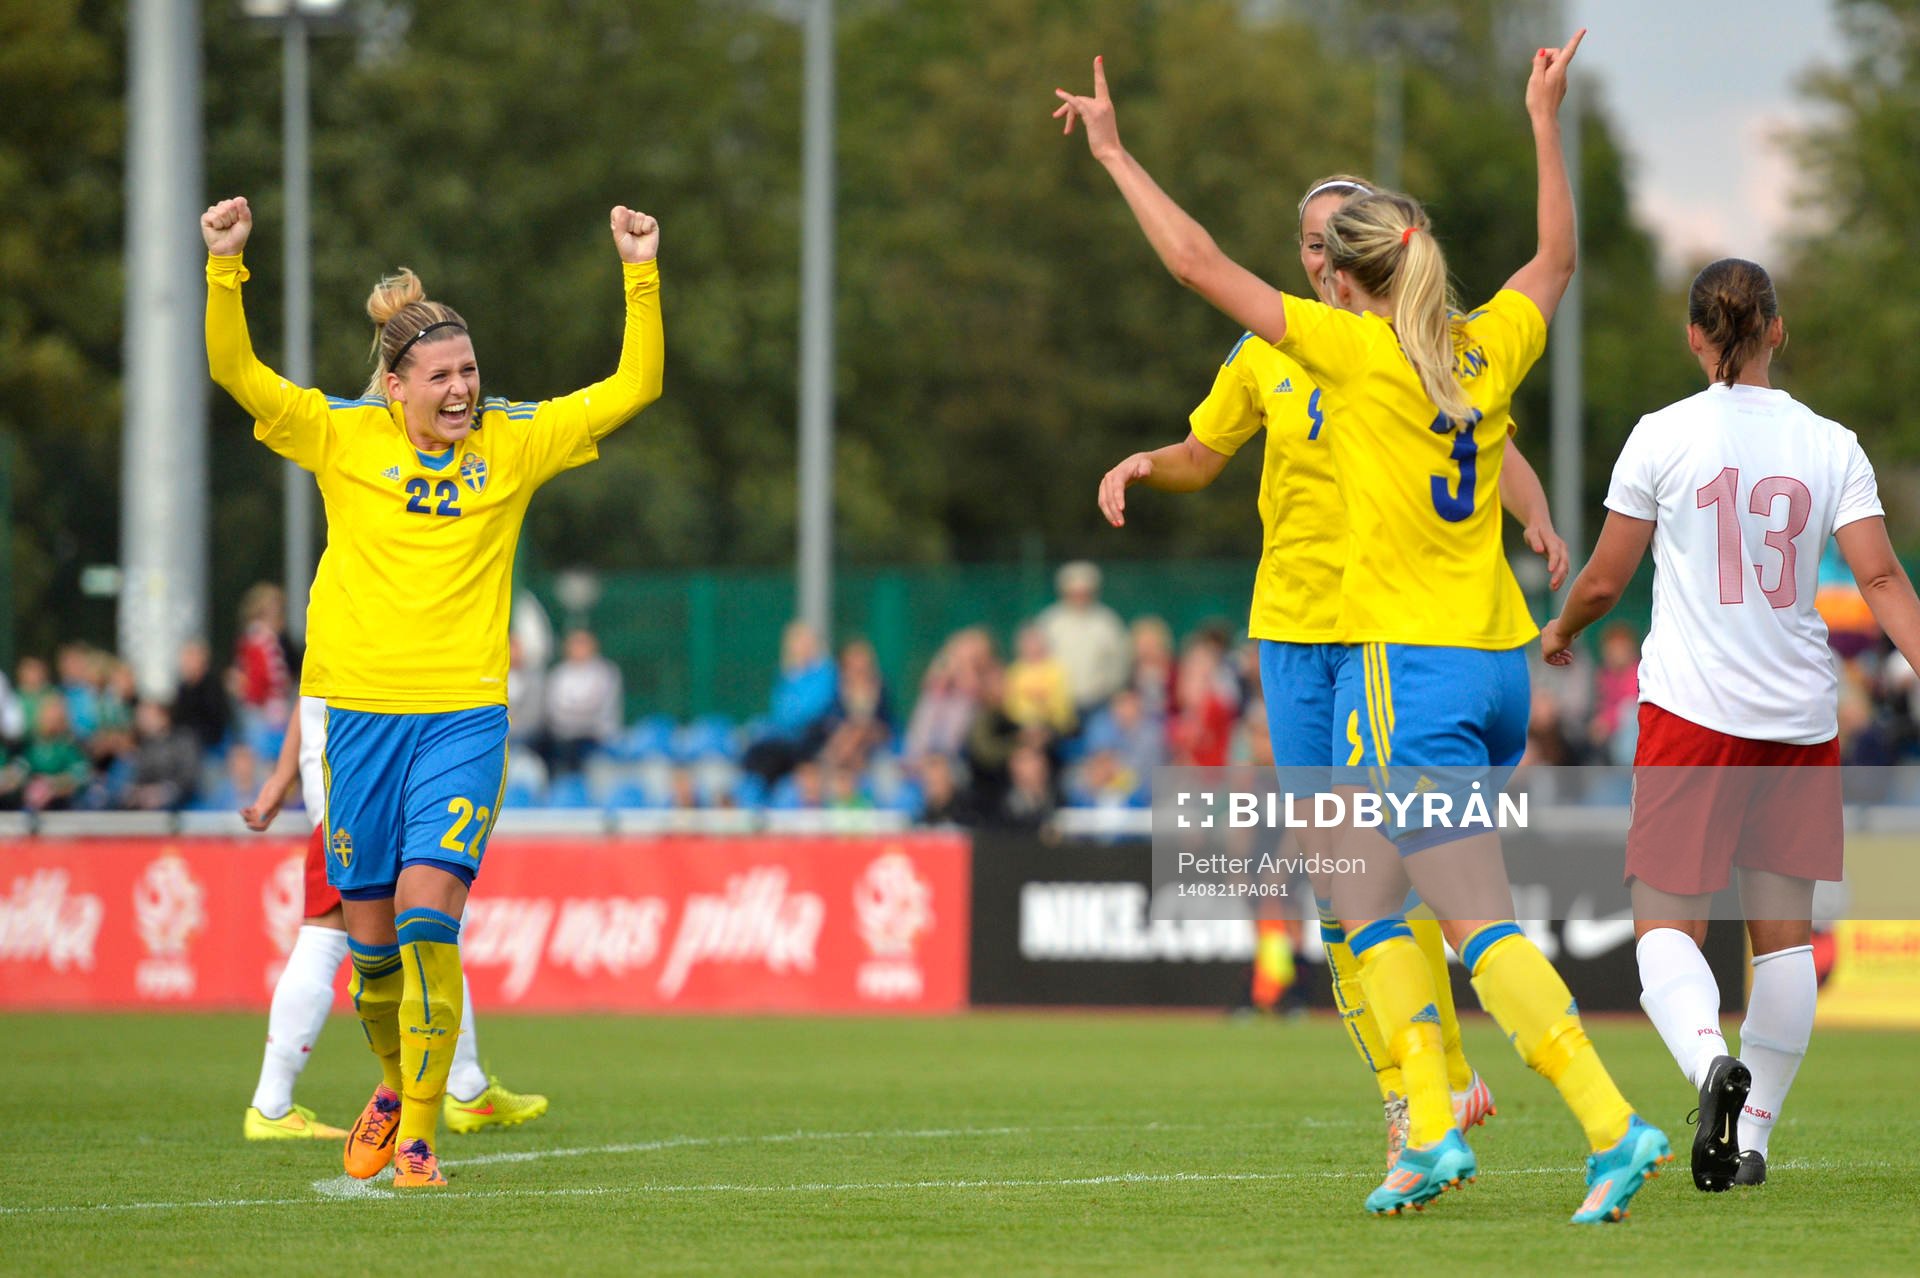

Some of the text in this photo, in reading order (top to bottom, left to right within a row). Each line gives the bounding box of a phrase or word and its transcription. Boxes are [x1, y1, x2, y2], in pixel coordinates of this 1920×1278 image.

[1429, 407, 1483, 523] 3
[404, 477, 462, 517] 22
[1696, 466, 1812, 609] 13
[440, 797, 491, 860] 22
[1743, 1104, 1772, 1121] OLSKA
